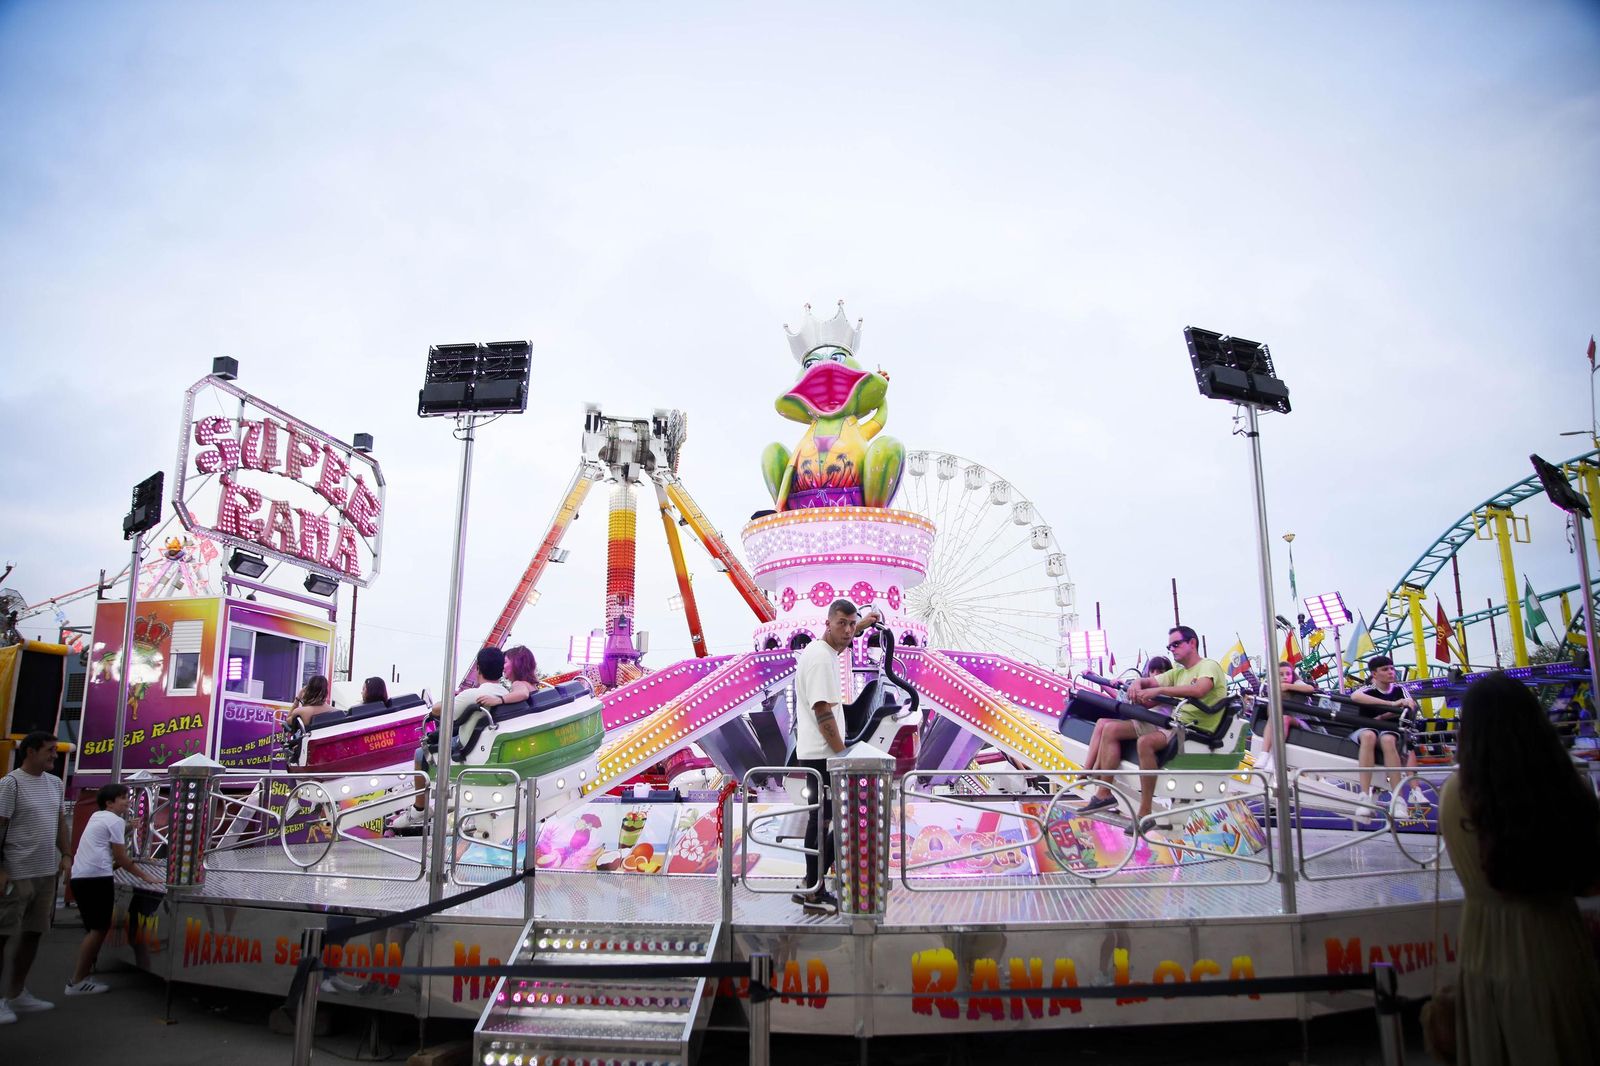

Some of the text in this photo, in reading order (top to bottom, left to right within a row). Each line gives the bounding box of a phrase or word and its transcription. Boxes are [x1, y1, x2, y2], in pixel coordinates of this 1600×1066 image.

[195, 416, 381, 537] SUPER
[211, 474, 361, 577] RANA
[151, 714, 203, 738] RANA
[225, 703, 274, 723] SUPER
[363, 730, 396, 743] RANITA
[369, 739, 394, 751] SHOW
[183, 917, 262, 967] MAXIMA
[911, 948, 1083, 1020] RANA
